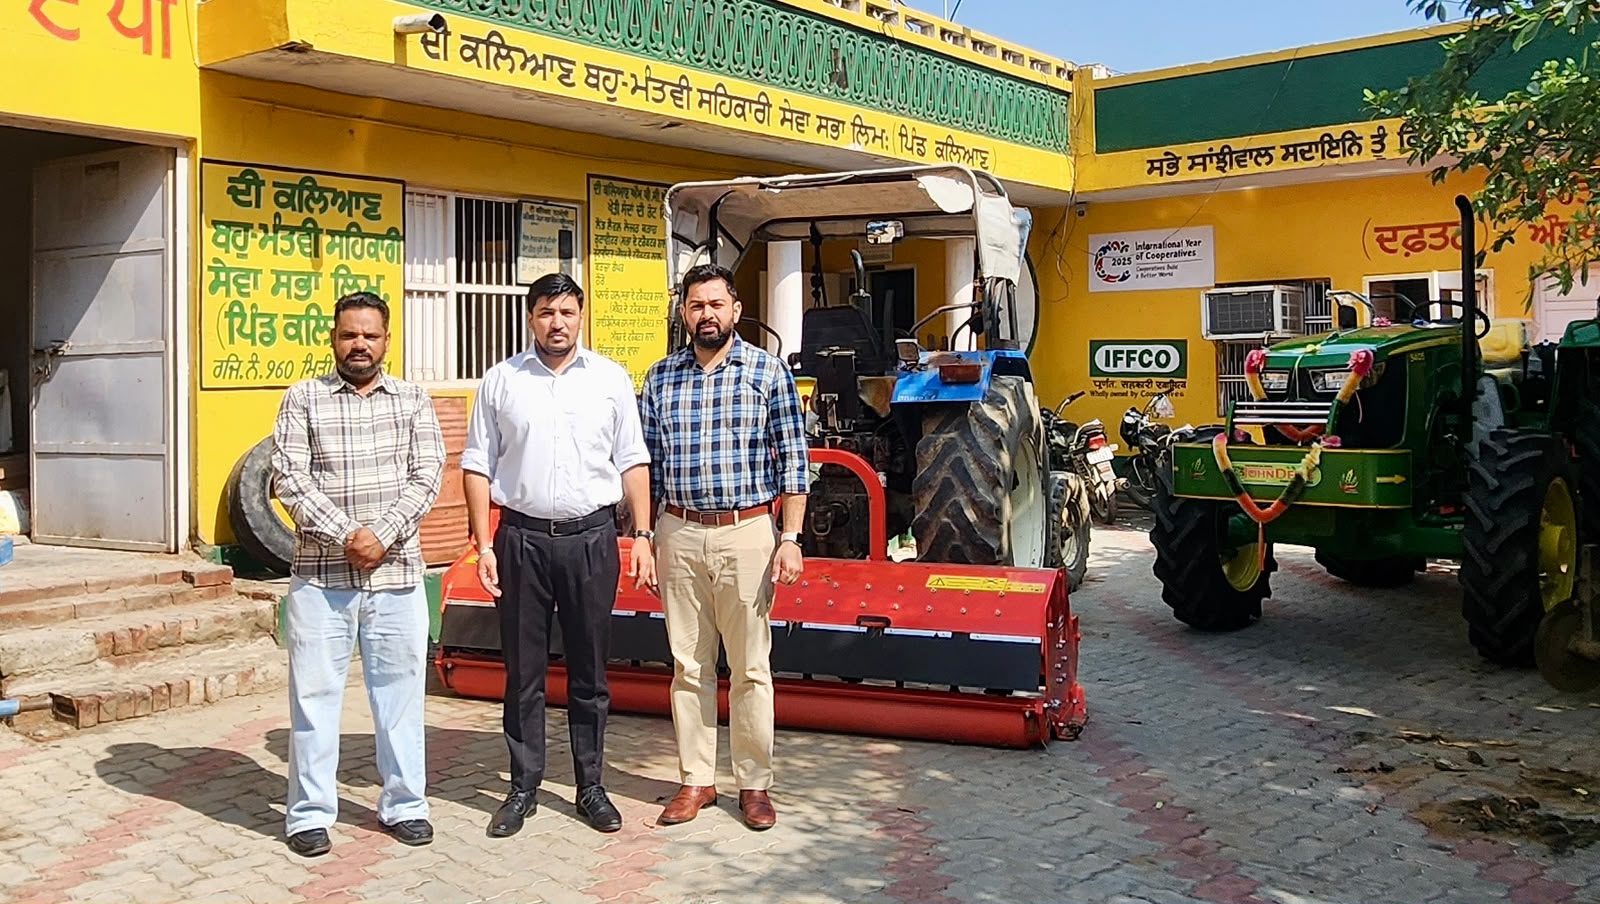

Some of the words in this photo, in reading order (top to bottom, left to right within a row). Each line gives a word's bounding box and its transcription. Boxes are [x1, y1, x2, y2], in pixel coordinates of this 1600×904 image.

[460, 30, 576, 88] ਕਲਿਆਣ
[697, 82, 772, 126] ਸਹਿਕਾਰੀ
[779, 98, 810, 134] ਸੇਵਾ
[816, 114, 845, 140] ਸਭਾ
[1146, 151, 1182, 177] ਸਭੇ
[1187, 144, 1276, 173] ਸਾਂਝੀਵਾਲ
[227, 168, 265, 209] ਦੀ
[272, 176, 383, 221] ਕਲਿਆਣ
[325, 222, 404, 265] ਸਹਿਕਾਰੀ
[1135, 239, 1183, 251] International
[1185, 239, 1202, 248] Year
[1135, 251, 1144, 260] of
[1145, 249, 1197, 261] Cooperatives
[1111, 257, 1132, 267] 2025
[207, 257, 263, 299] ਸੇਵਾ
[271, 269, 322, 301] ਸਭਾ
[1104, 348, 1171, 369] IFFCO
